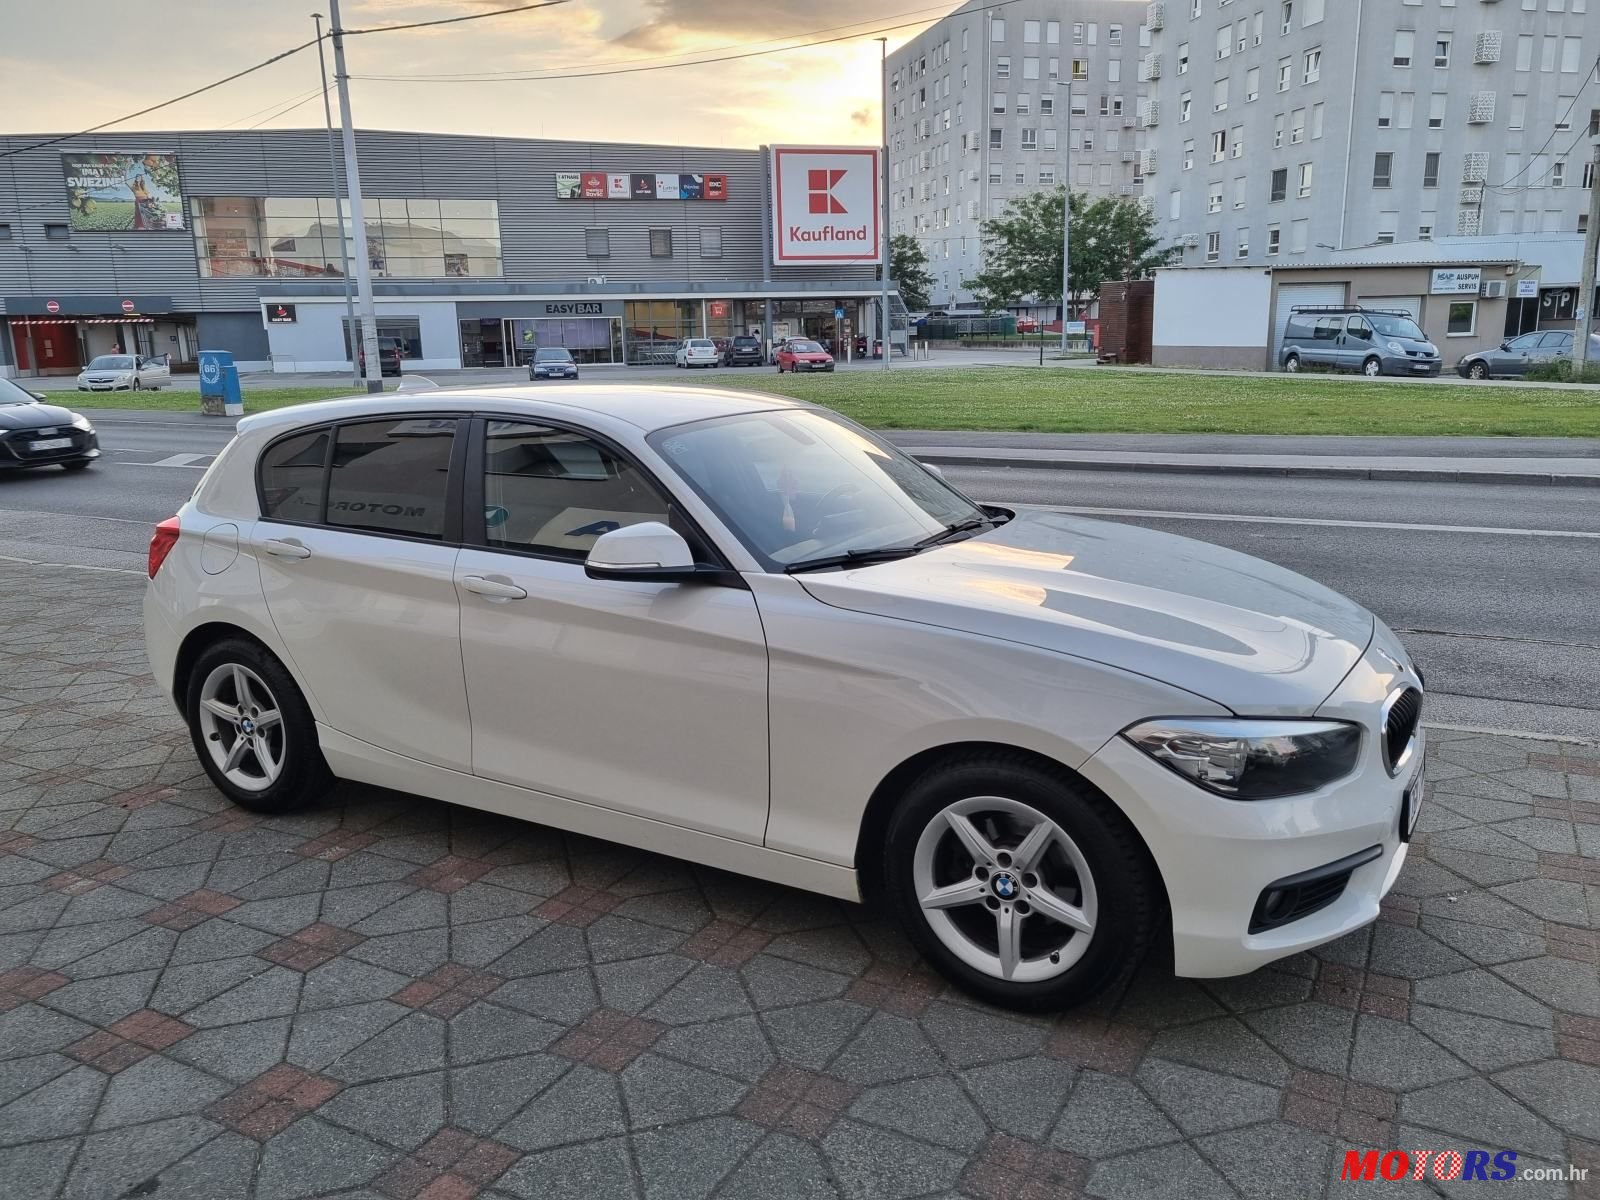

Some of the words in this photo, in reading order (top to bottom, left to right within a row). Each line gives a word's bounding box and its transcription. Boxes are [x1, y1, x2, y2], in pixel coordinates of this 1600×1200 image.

[790, 225, 867, 242] Kaufland
[1456, 273, 1480, 281] AUSPUH
[545, 304, 574, 314] EASY
[577, 304, 600, 313] BAR
